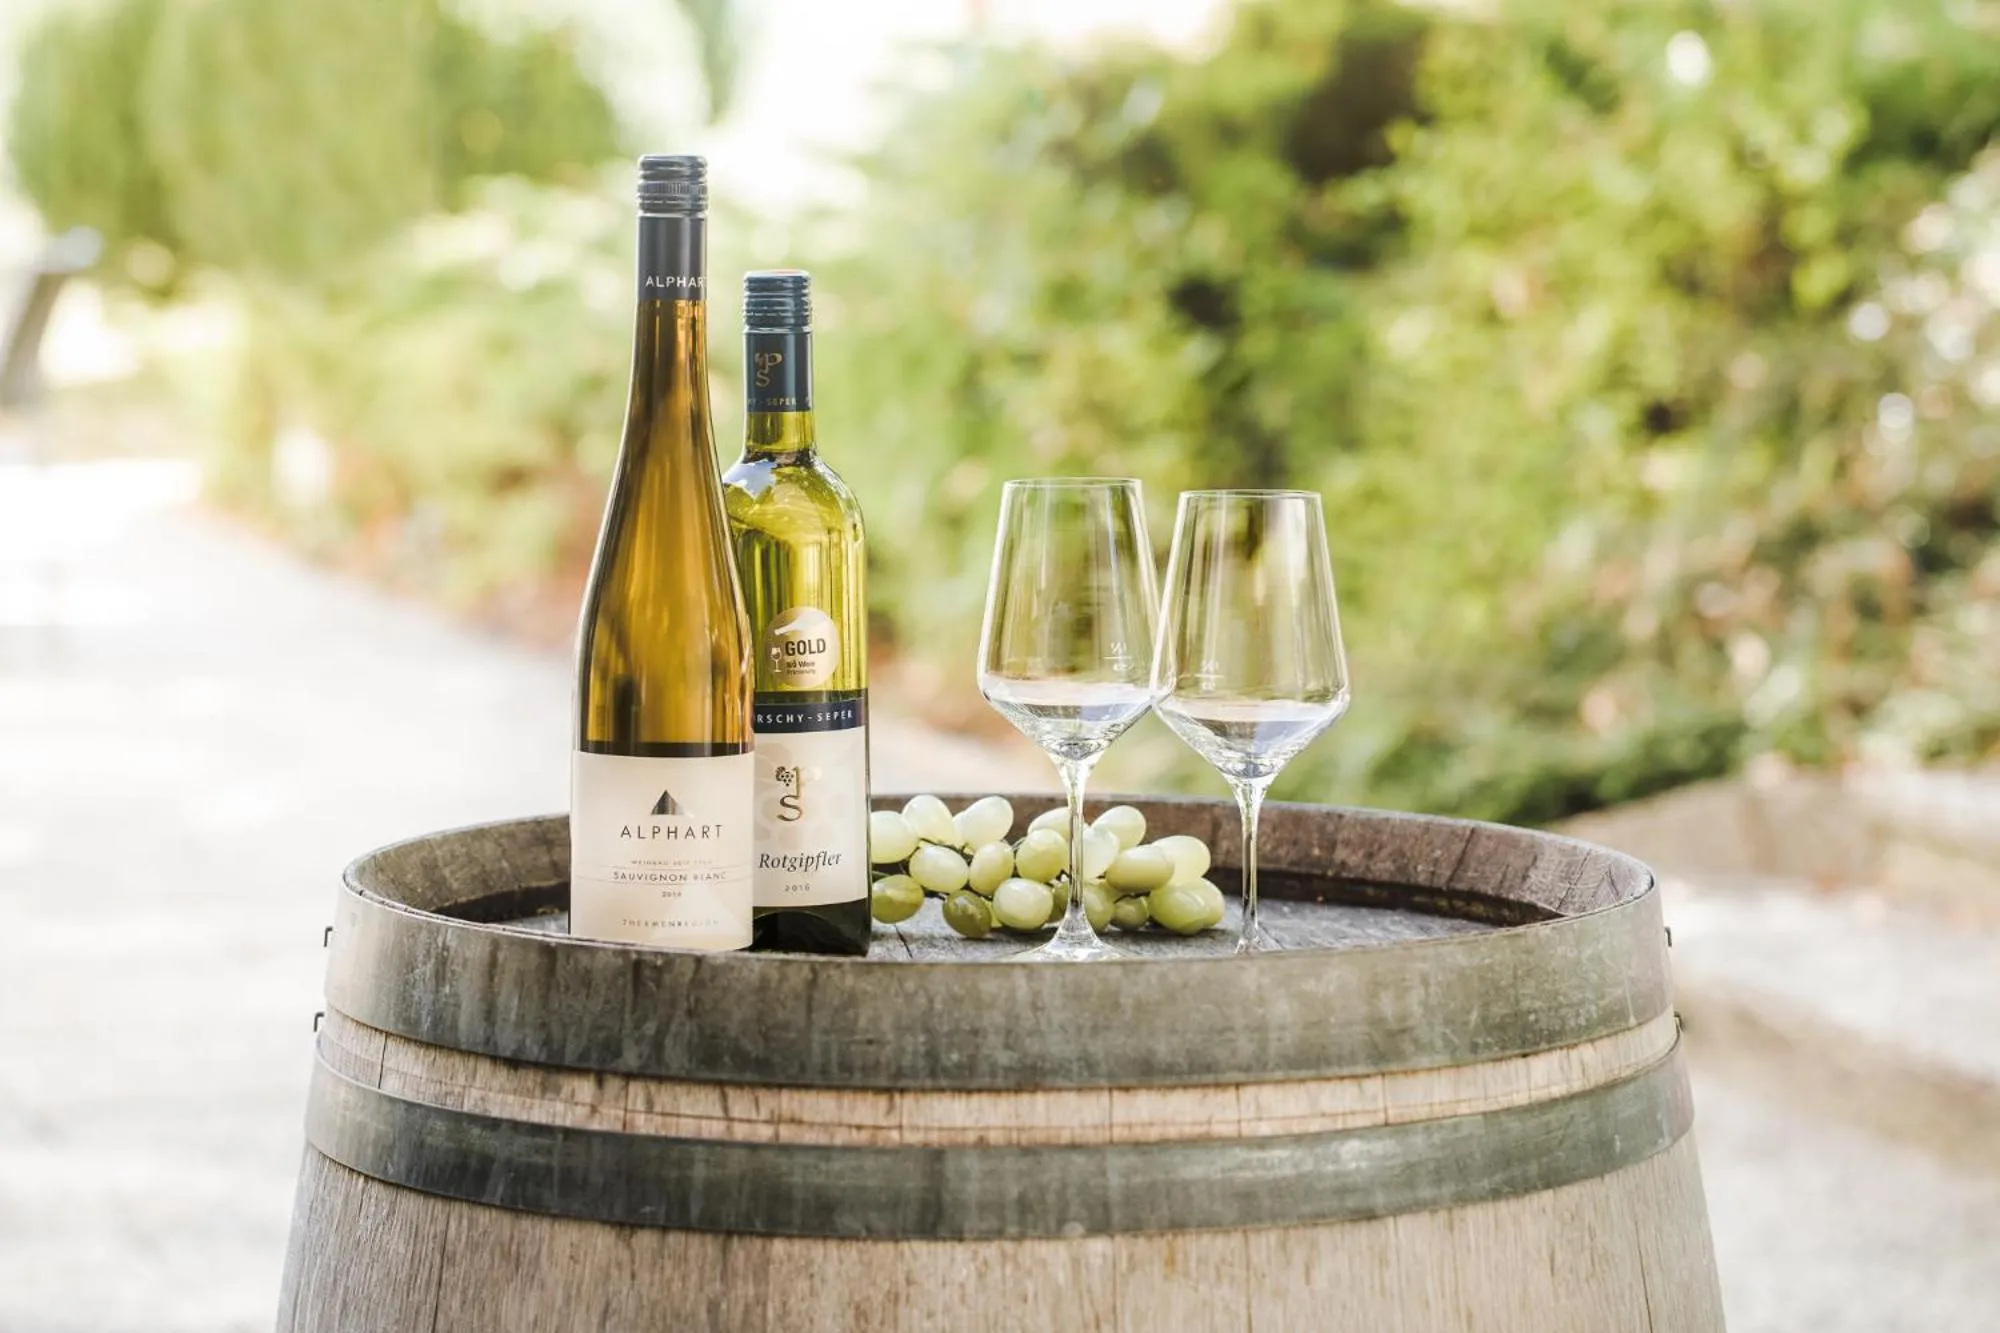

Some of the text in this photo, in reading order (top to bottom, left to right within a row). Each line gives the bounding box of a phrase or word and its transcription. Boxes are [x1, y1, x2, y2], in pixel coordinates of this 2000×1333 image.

[785, 638, 826, 656] GOLD
[620, 824, 723, 840] ALPHART
[759, 850, 842, 872] Rotgipfler
[613, 871, 727, 883] SAUVIGNON BLANC
[784, 883, 811, 893] 2016
